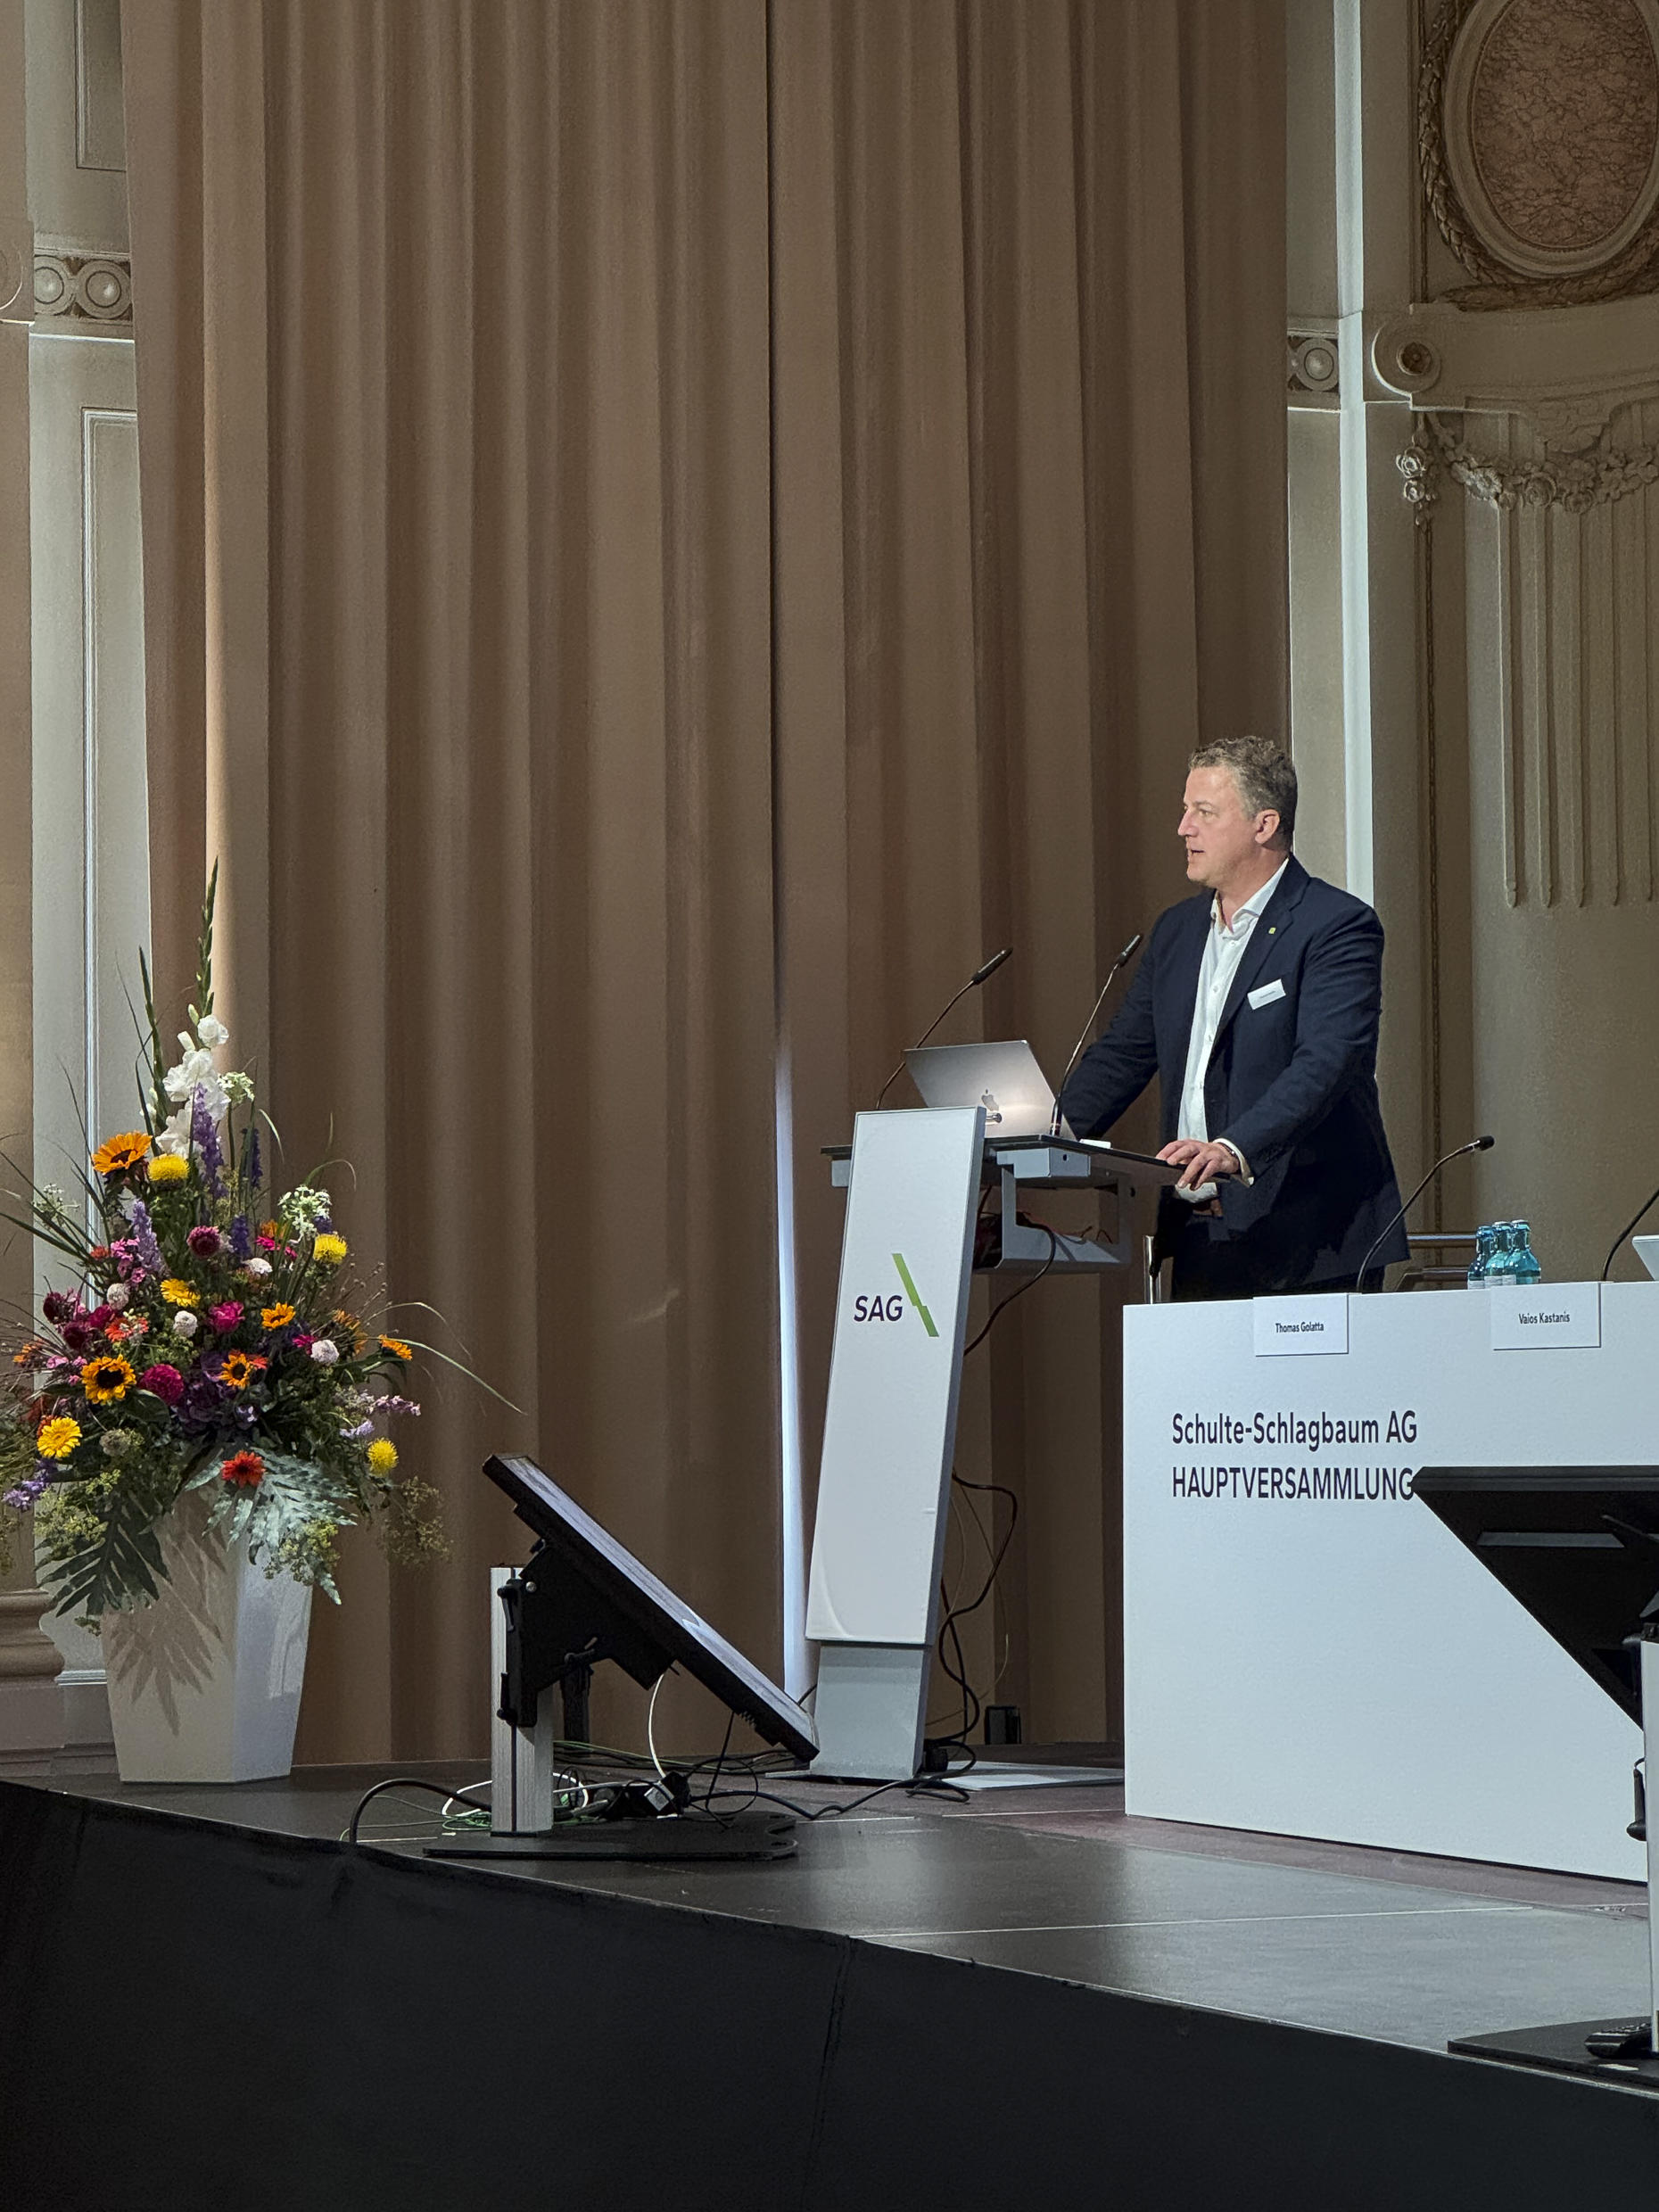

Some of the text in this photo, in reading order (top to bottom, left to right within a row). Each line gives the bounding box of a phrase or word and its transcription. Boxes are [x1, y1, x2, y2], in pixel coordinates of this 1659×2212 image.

[854, 1295, 903, 1322] SAG
[1518, 1310, 1571, 1325] Vaios Kastanis
[1275, 1321, 1325, 1333] Thomas Golatta
[1172, 1410, 1417, 1452] Schulte-Schlagbaum AG
[1172, 1466, 1415, 1500] HAUPTVERSAMMLUNG
